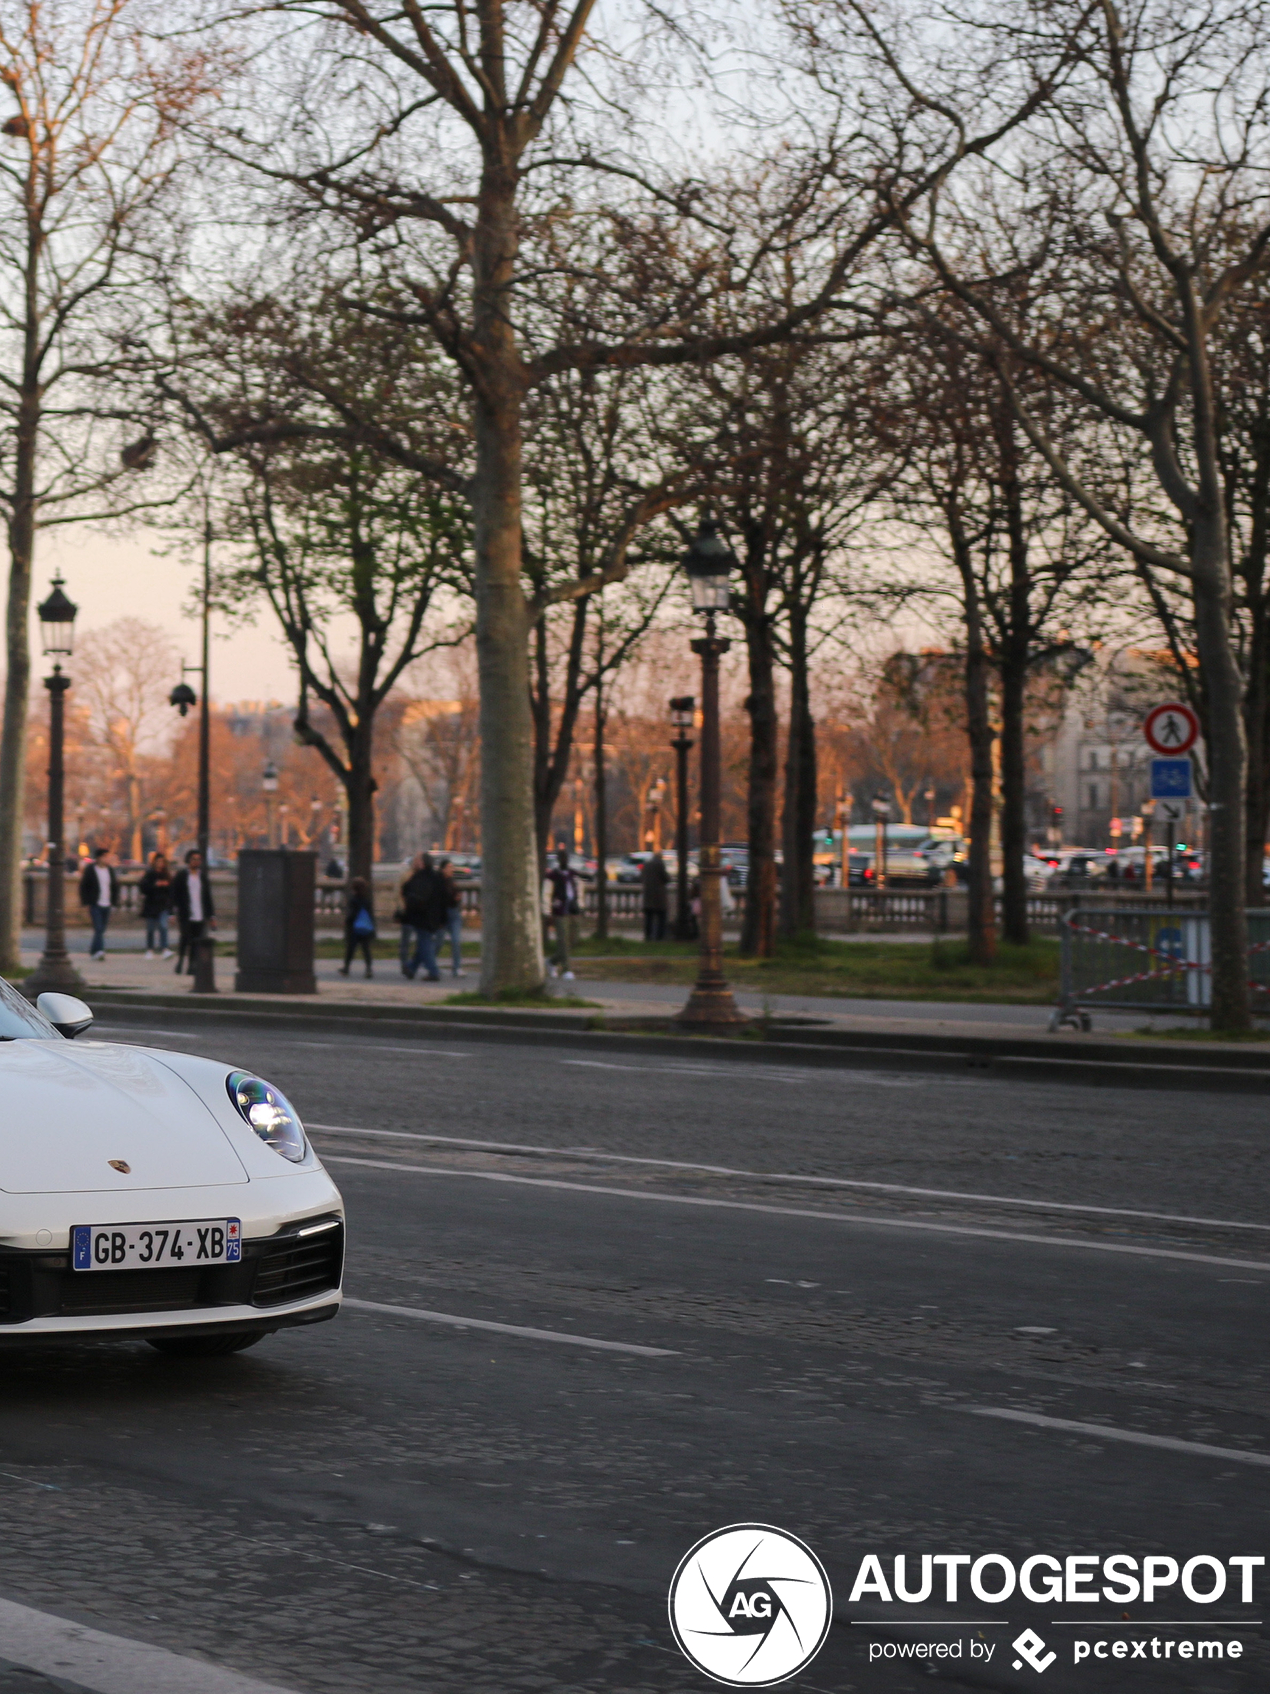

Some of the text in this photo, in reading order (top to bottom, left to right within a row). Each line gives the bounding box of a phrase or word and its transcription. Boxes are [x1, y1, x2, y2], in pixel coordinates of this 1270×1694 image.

[94, 1227, 224, 1264] GB-374-XB
[227, 1242, 239, 1257] 75
[80, 1251, 85, 1261] F
